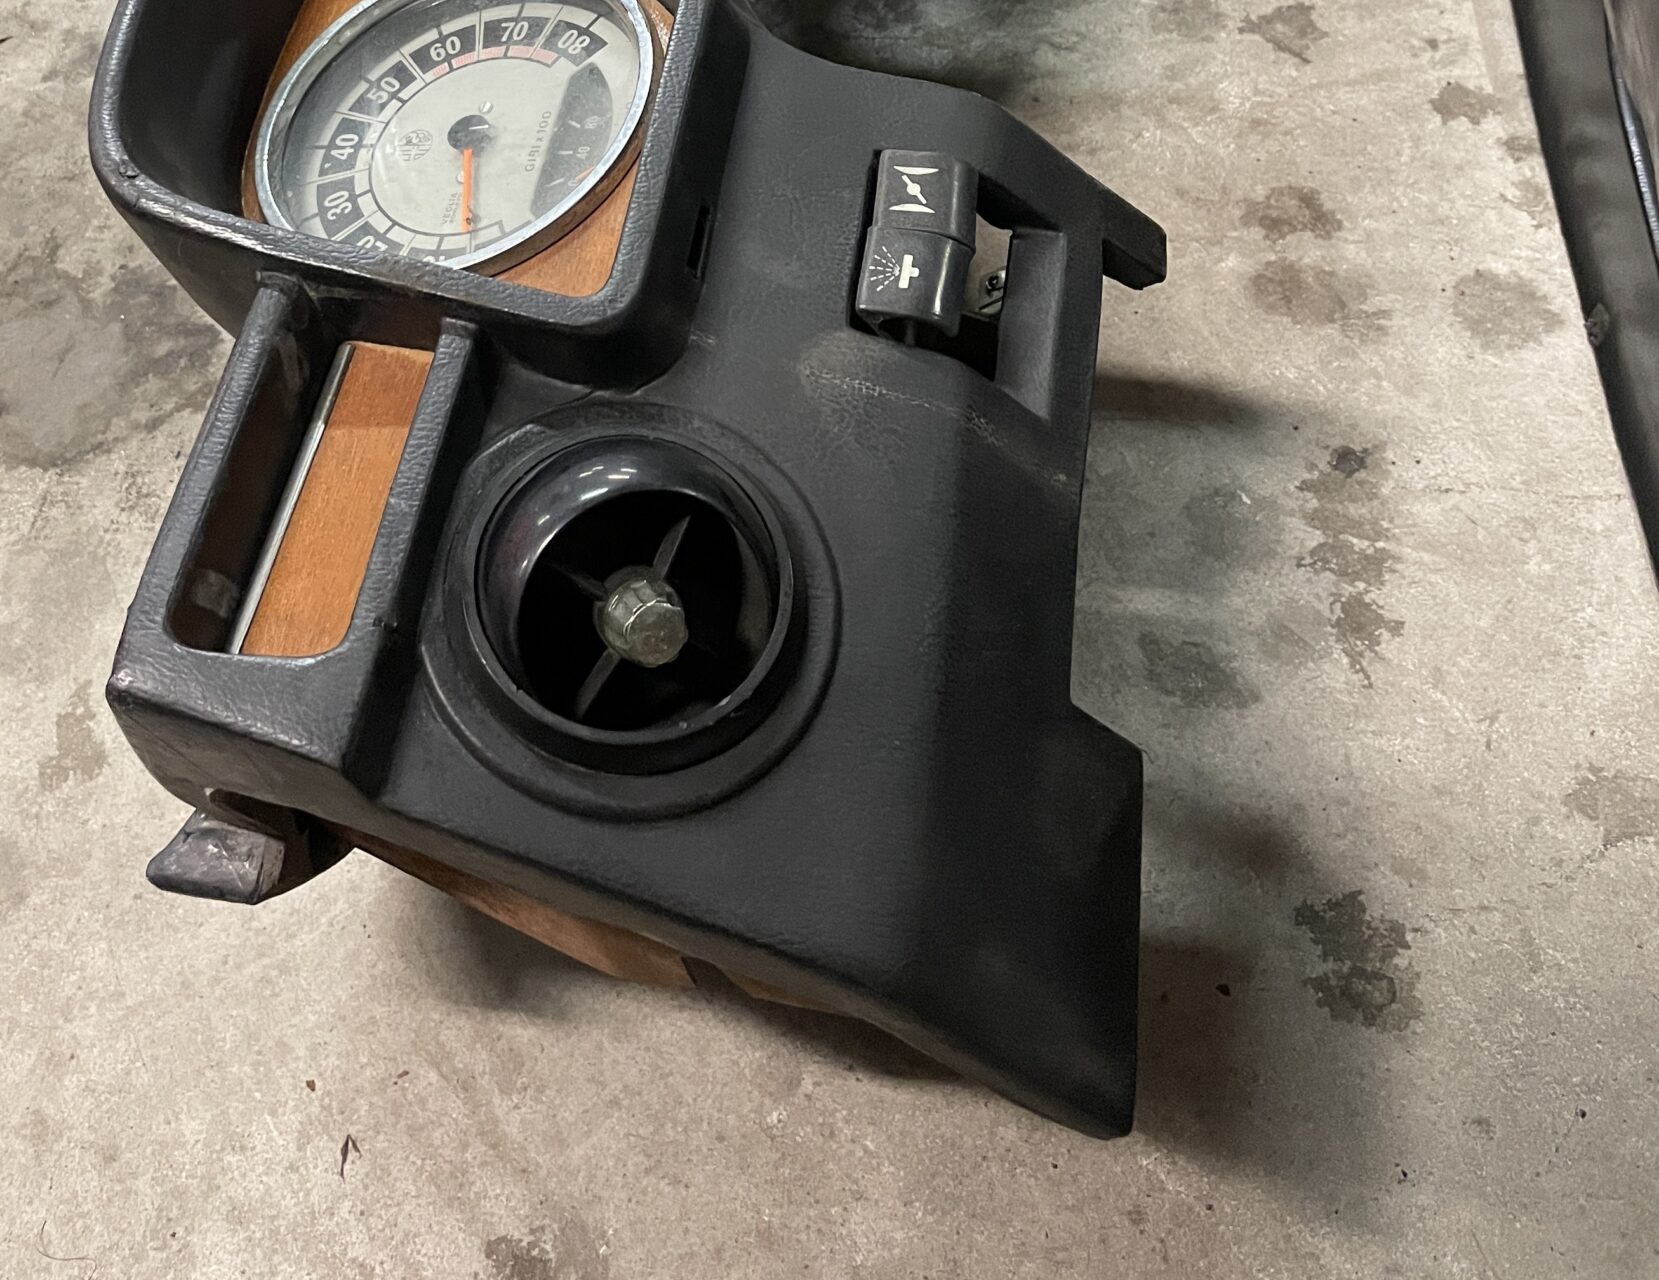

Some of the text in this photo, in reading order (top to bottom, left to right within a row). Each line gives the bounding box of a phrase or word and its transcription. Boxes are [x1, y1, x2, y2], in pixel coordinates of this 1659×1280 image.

[500, 21, 529, 42] 70
[557, 29, 590, 55] 80
[429, 35, 461, 61] 60
[366, 76, 400, 104] 50
[536, 110, 552, 134] 100
[329, 133, 360, 161] 40
[323, 190, 353, 220] 30
